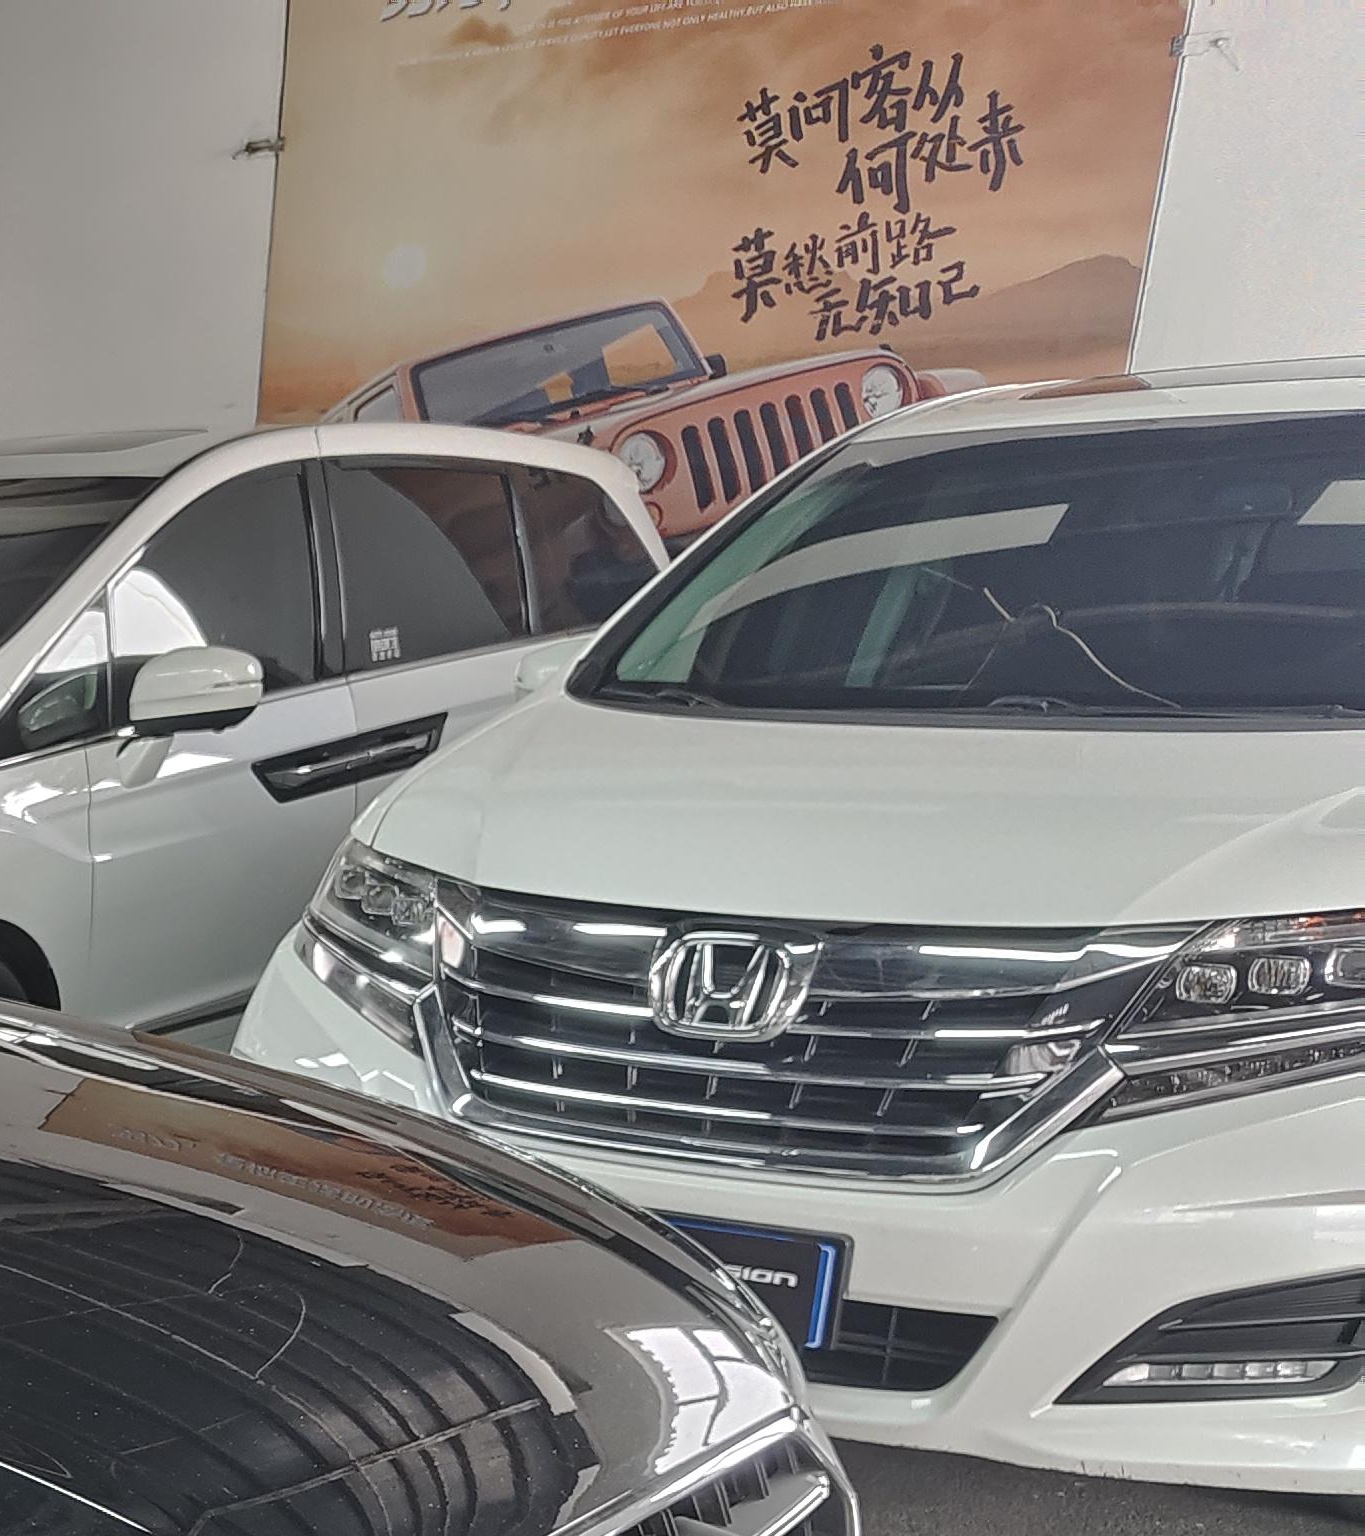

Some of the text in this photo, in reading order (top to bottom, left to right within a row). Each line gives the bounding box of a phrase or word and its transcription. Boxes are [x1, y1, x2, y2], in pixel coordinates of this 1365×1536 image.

[835, 90, 1025, 214] 何处来
[731, 211, 957, 323] 莫愁前路
